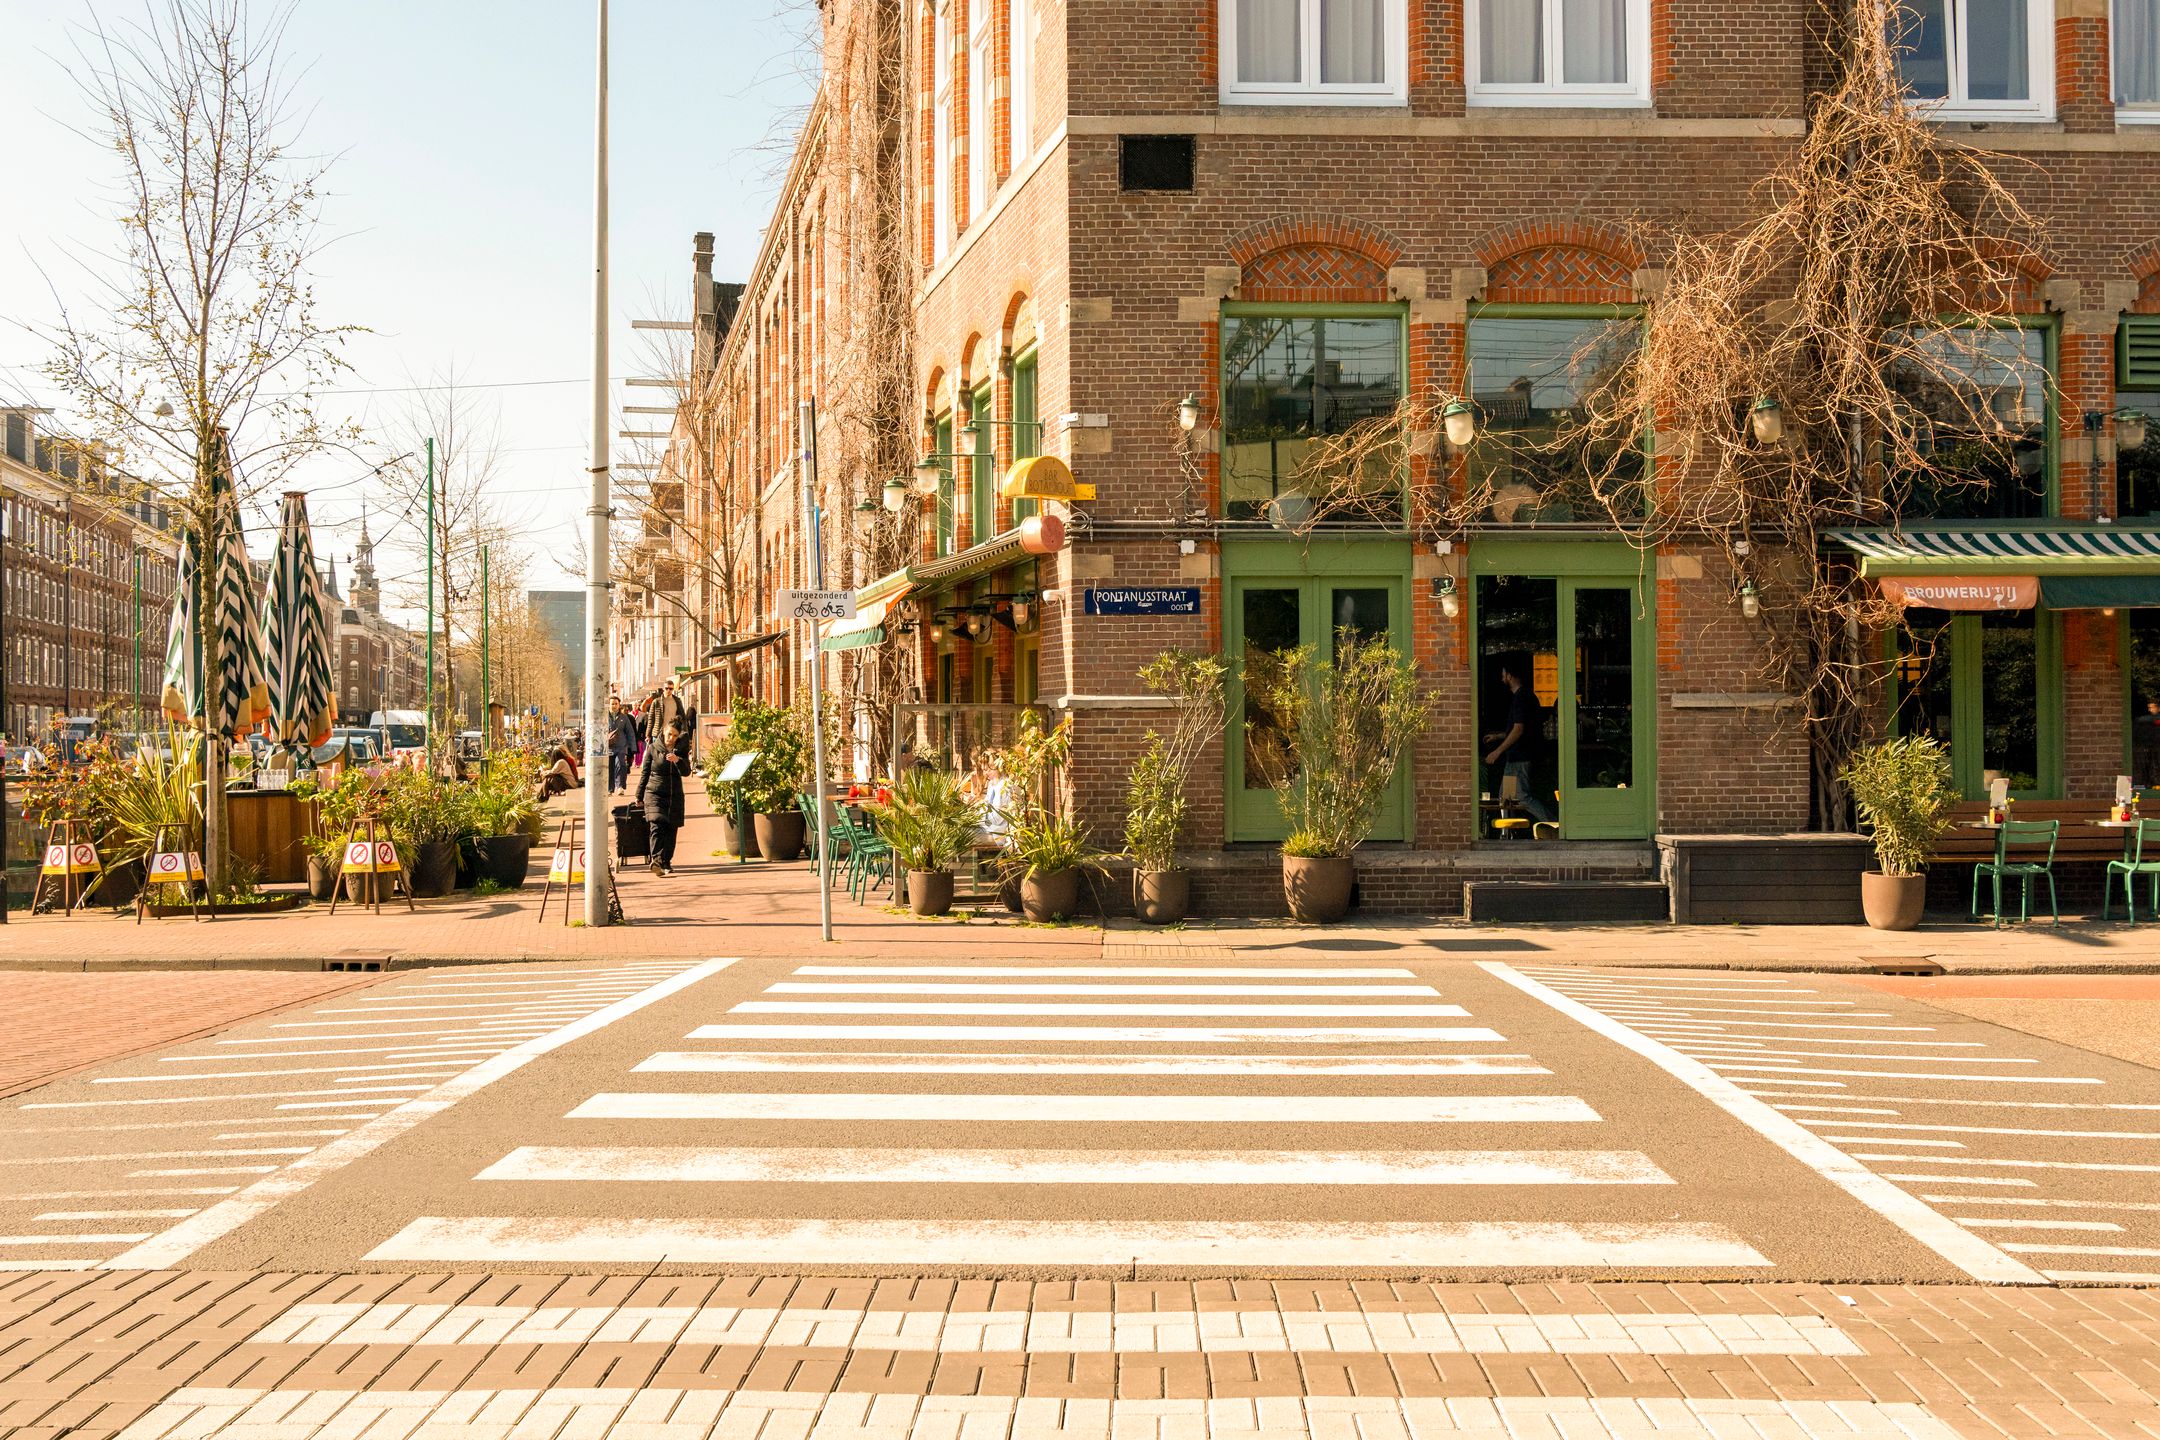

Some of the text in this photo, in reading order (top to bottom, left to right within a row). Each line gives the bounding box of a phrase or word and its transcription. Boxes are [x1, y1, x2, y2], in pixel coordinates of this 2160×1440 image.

[1044, 469, 1058, 481] BAR
[791, 591, 848, 600] uitgezonderd
[1096, 591, 1187, 602] PONTANUSSTRAAT
[1904, 586, 1991, 599] BROUWERIJ
